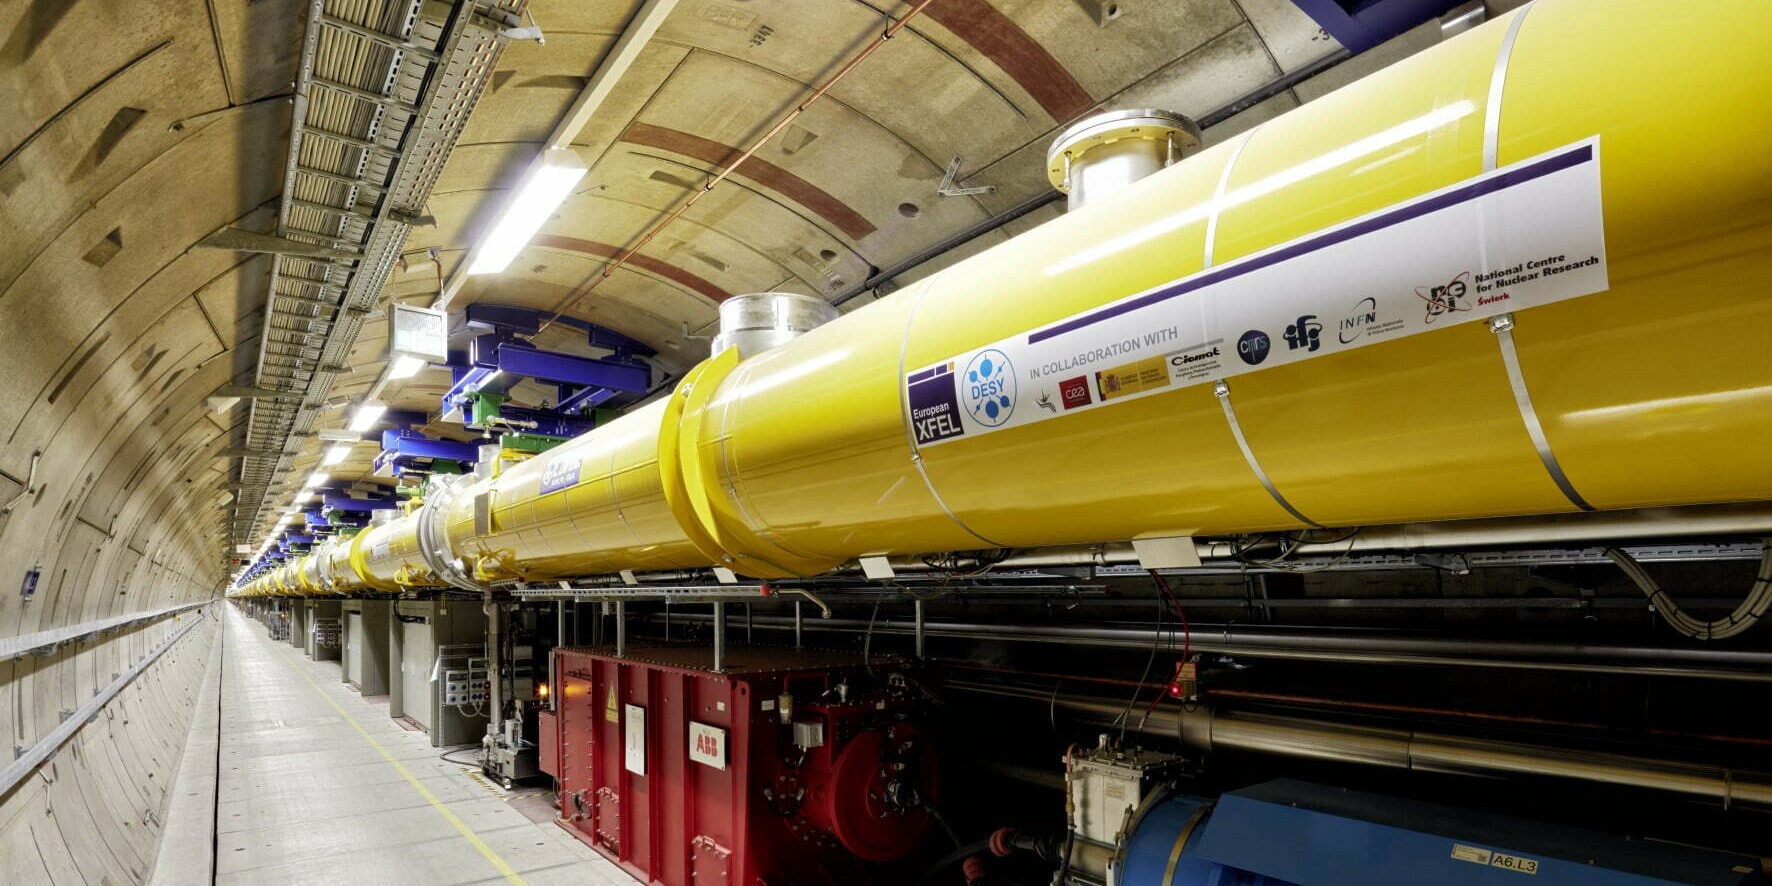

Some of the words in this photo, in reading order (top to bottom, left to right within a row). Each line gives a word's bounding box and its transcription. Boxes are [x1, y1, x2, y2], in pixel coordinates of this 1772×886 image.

[1474, 263, 1523, 284] National
[1526, 254, 1566, 270] Centre
[1476, 284, 1492, 294] for
[1495, 270, 1540, 288] Nuclear
[1543, 256, 1600, 277] Research
[1340, 311, 1376, 330] INFN
[1030, 367, 1040, 379] IN
[1042, 336, 1141, 373] COLLABORATION
[1143, 326, 1178, 347] WITH
[971, 377, 1004, 400] DESY
[913, 403, 950, 419] European
[916, 413, 961, 440] XFEL
[696, 733, 718, 757] ABB
[1494, 855, 1536, 872] A6.L3
